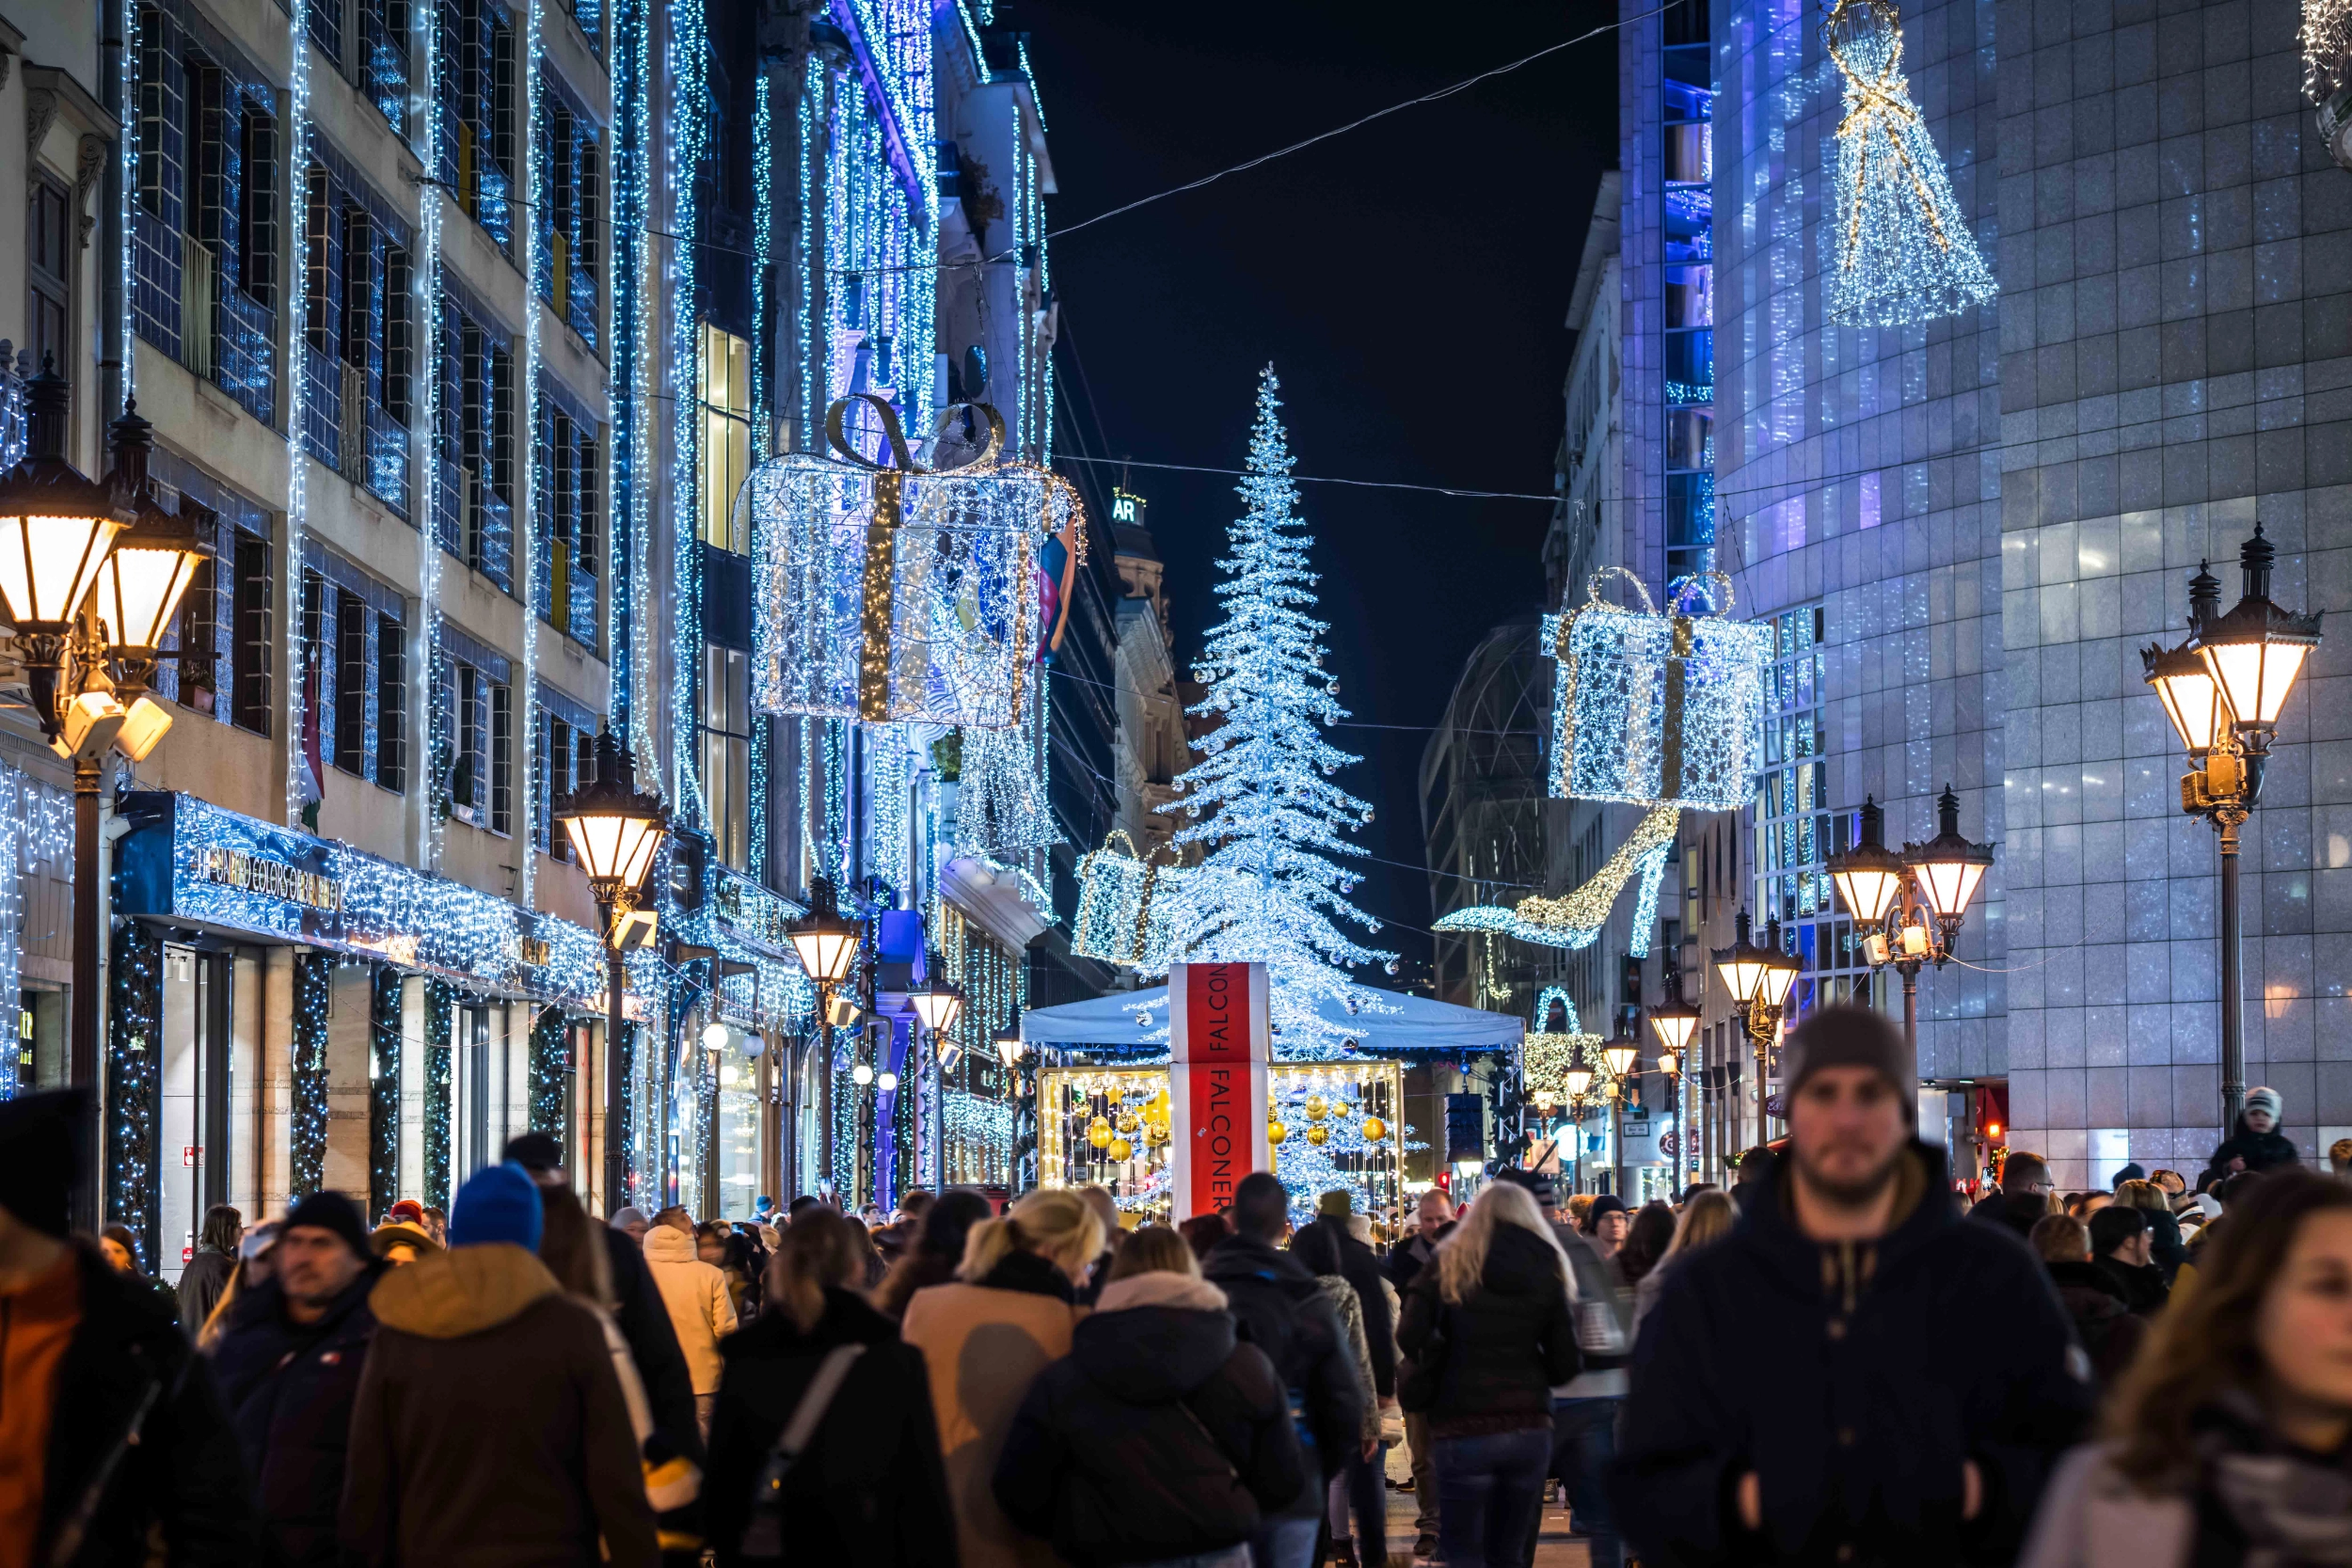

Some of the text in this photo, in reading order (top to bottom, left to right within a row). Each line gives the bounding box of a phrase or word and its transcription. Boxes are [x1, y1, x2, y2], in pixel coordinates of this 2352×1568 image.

[1113, 499, 1135, 521] AR
[252, 856, 288, 898] COLORS
[289, 865, 302, 902] OF
[1211, 1069, 1232, 1209] FALCONER
